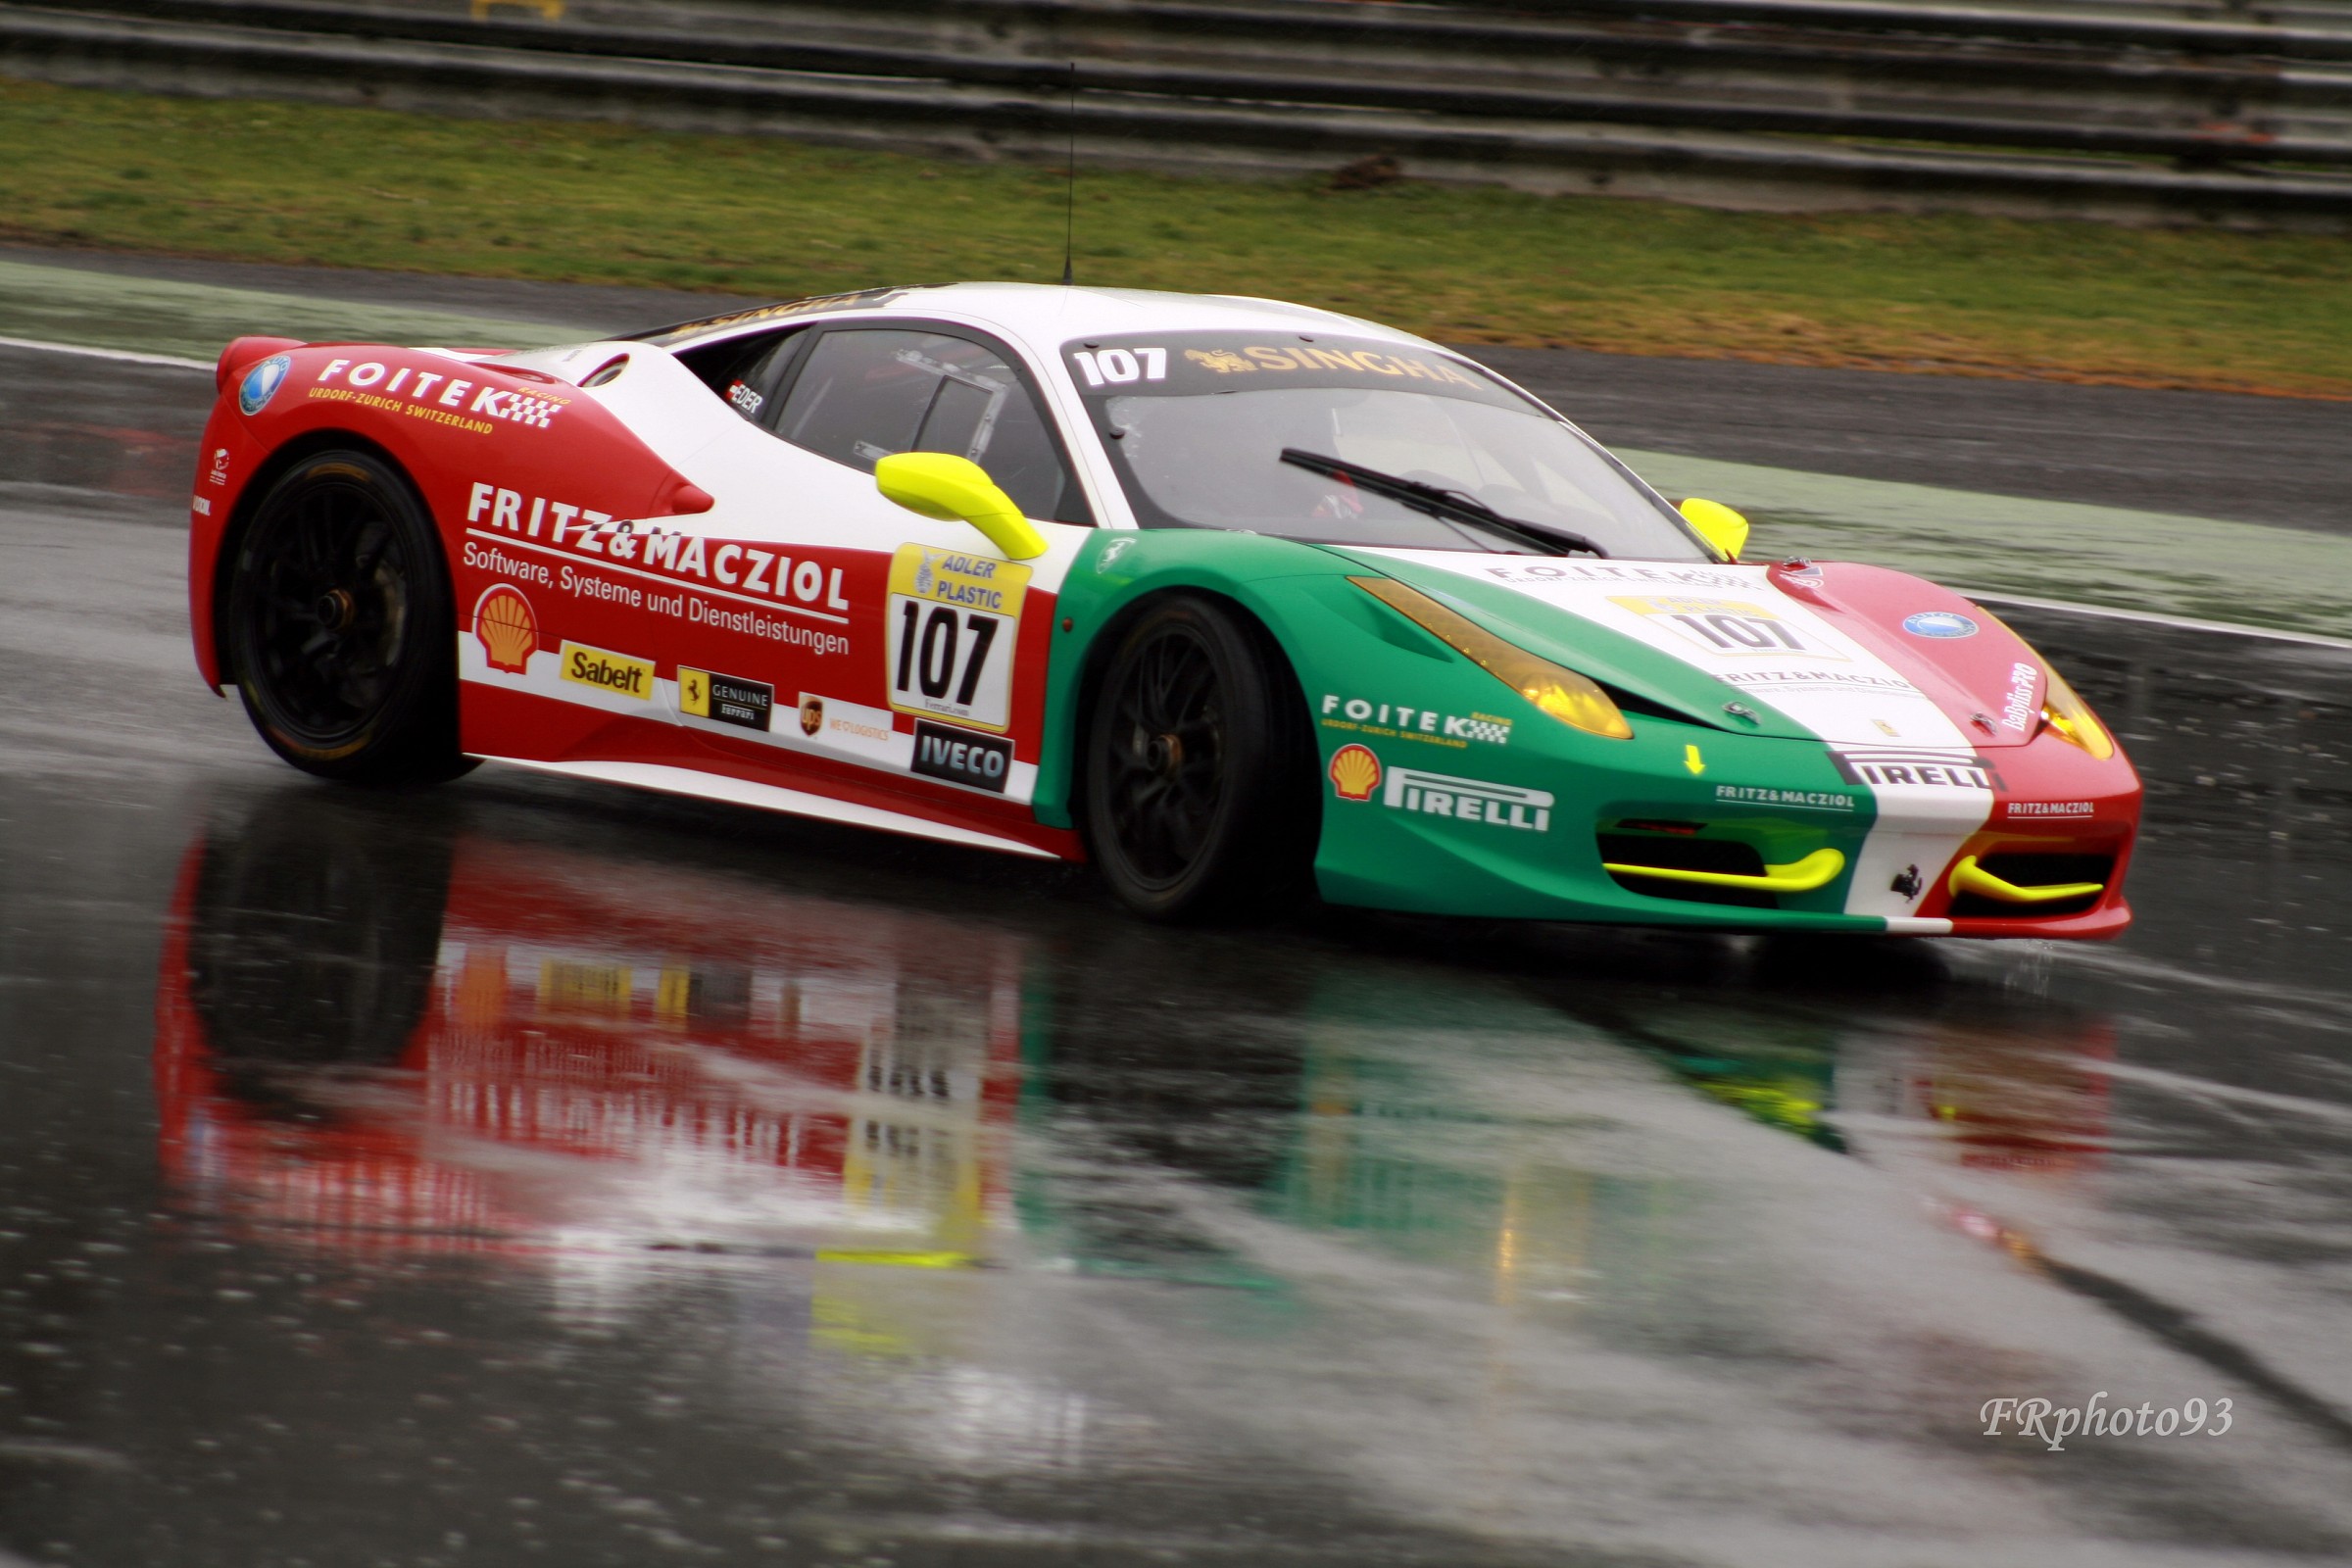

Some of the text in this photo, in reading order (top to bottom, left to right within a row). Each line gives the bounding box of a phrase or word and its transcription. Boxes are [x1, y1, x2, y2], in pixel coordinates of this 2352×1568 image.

[1074, 347, 1168, 387] 107
[1243, 346, 1484, 391] SINGHA
[318, 359, 512, 418] FOITEK
[517, 386, 572, 406] RACING
[732, 383, 763, 413] EDER
[309, 387, 493, 434] URDORF-ZURICH SWITZERLAND
[466, 481, 850, 611] FRITZ&MACZIOL
[942, 555, 997, 579] ADLER
[1482, 565, 1696, 582] FOITEK
[464, 541, 850, 656] Software, Systeme und Dienstleistungen
[937, 580, 1003, 610] PLASTIC
[1670, 613, 1807, 651] 107
[570, 651, 643, 694] Sabelt
[896, 600, 1000, 707] 107
[711, 684, 768, 708] GENUINE
[1322, 694, 1471, 738] FOITEK
[803, 709, 821, 731] ups
[920, 735, 1004, 778] IVECO
[1826, 751, 2007, 792] PIRELLI
[1384, 765, 1555, 832] PIRELLI
[1716, 785, 1855, 808] FRITZ&MACZIOL
[2008, 802, 2093, 814] FRITZ&MACZIOL
